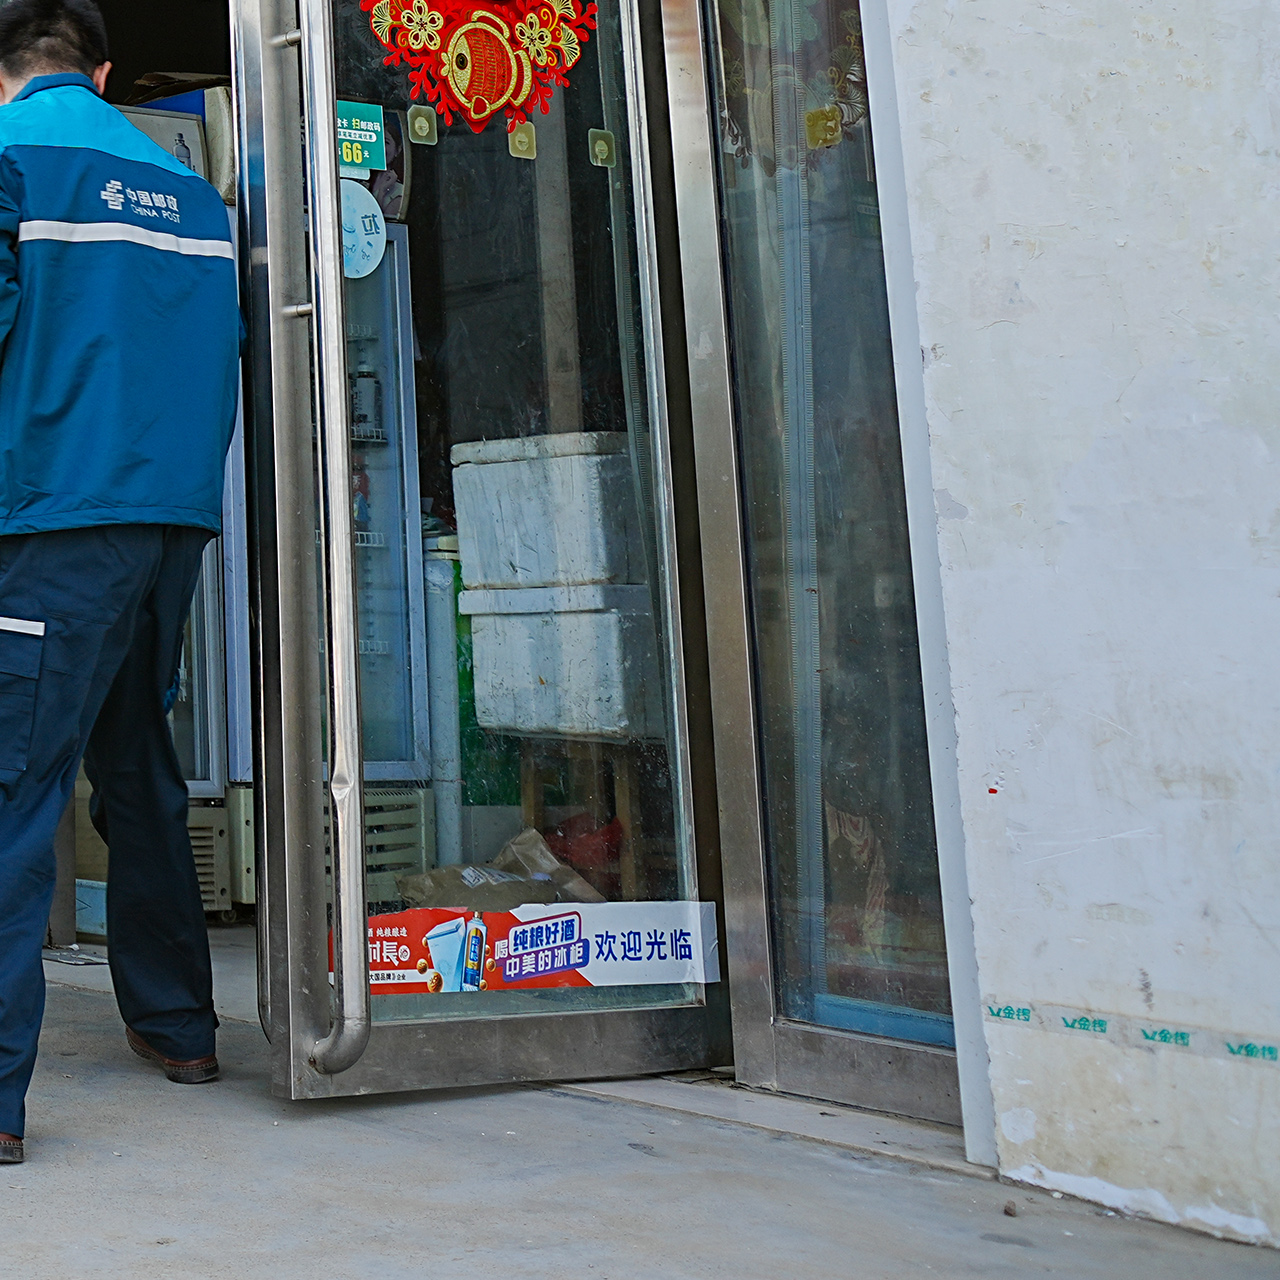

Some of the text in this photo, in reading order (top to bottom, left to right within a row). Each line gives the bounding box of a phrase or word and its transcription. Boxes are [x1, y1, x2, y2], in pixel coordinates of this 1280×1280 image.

[342, 141, 363, 164] 66
[125, 187, 179, 212] 中国邮政
[130, 204, 180, 224] CHINA POST
[494, 939, 509, 961] 喝
[513, 918, 576, 953] 纯粮好酒
[594, 928, 693, 962] 欢迎光临
[505, 942, 584, 978] 中美的冰柜
